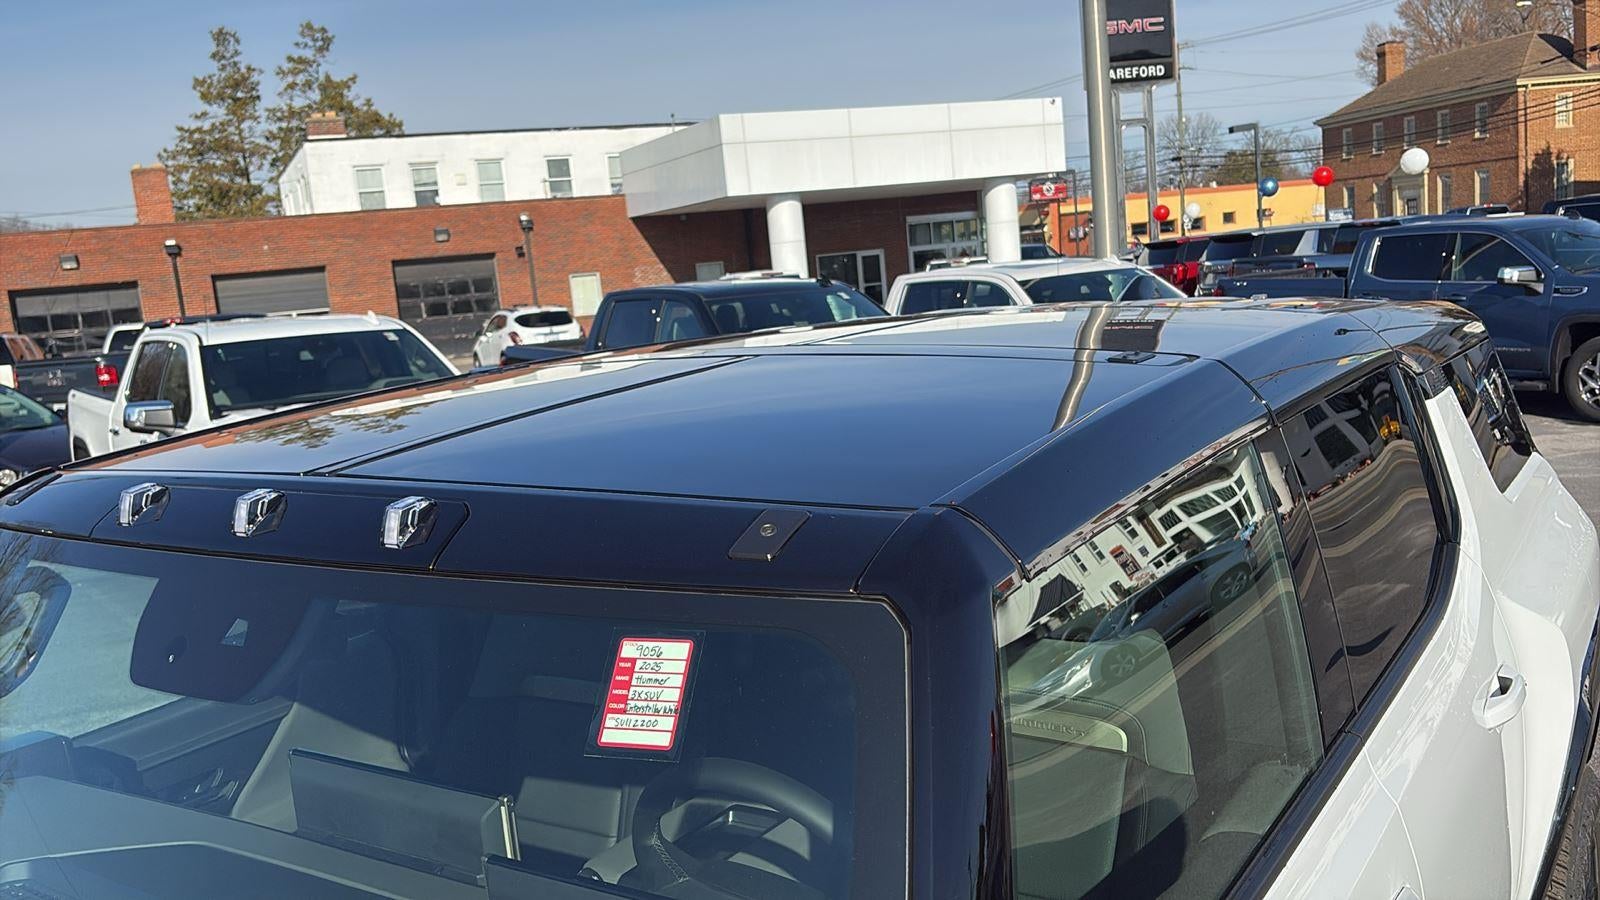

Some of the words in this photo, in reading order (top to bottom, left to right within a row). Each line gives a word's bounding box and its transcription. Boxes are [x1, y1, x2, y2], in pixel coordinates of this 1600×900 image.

[1109, 64, 1166, 80] AREFORD
[636, 644, 663, 658] 9056
[639, 661, 664, 672] 2025
[635, 675, 670, 685] Hummer
